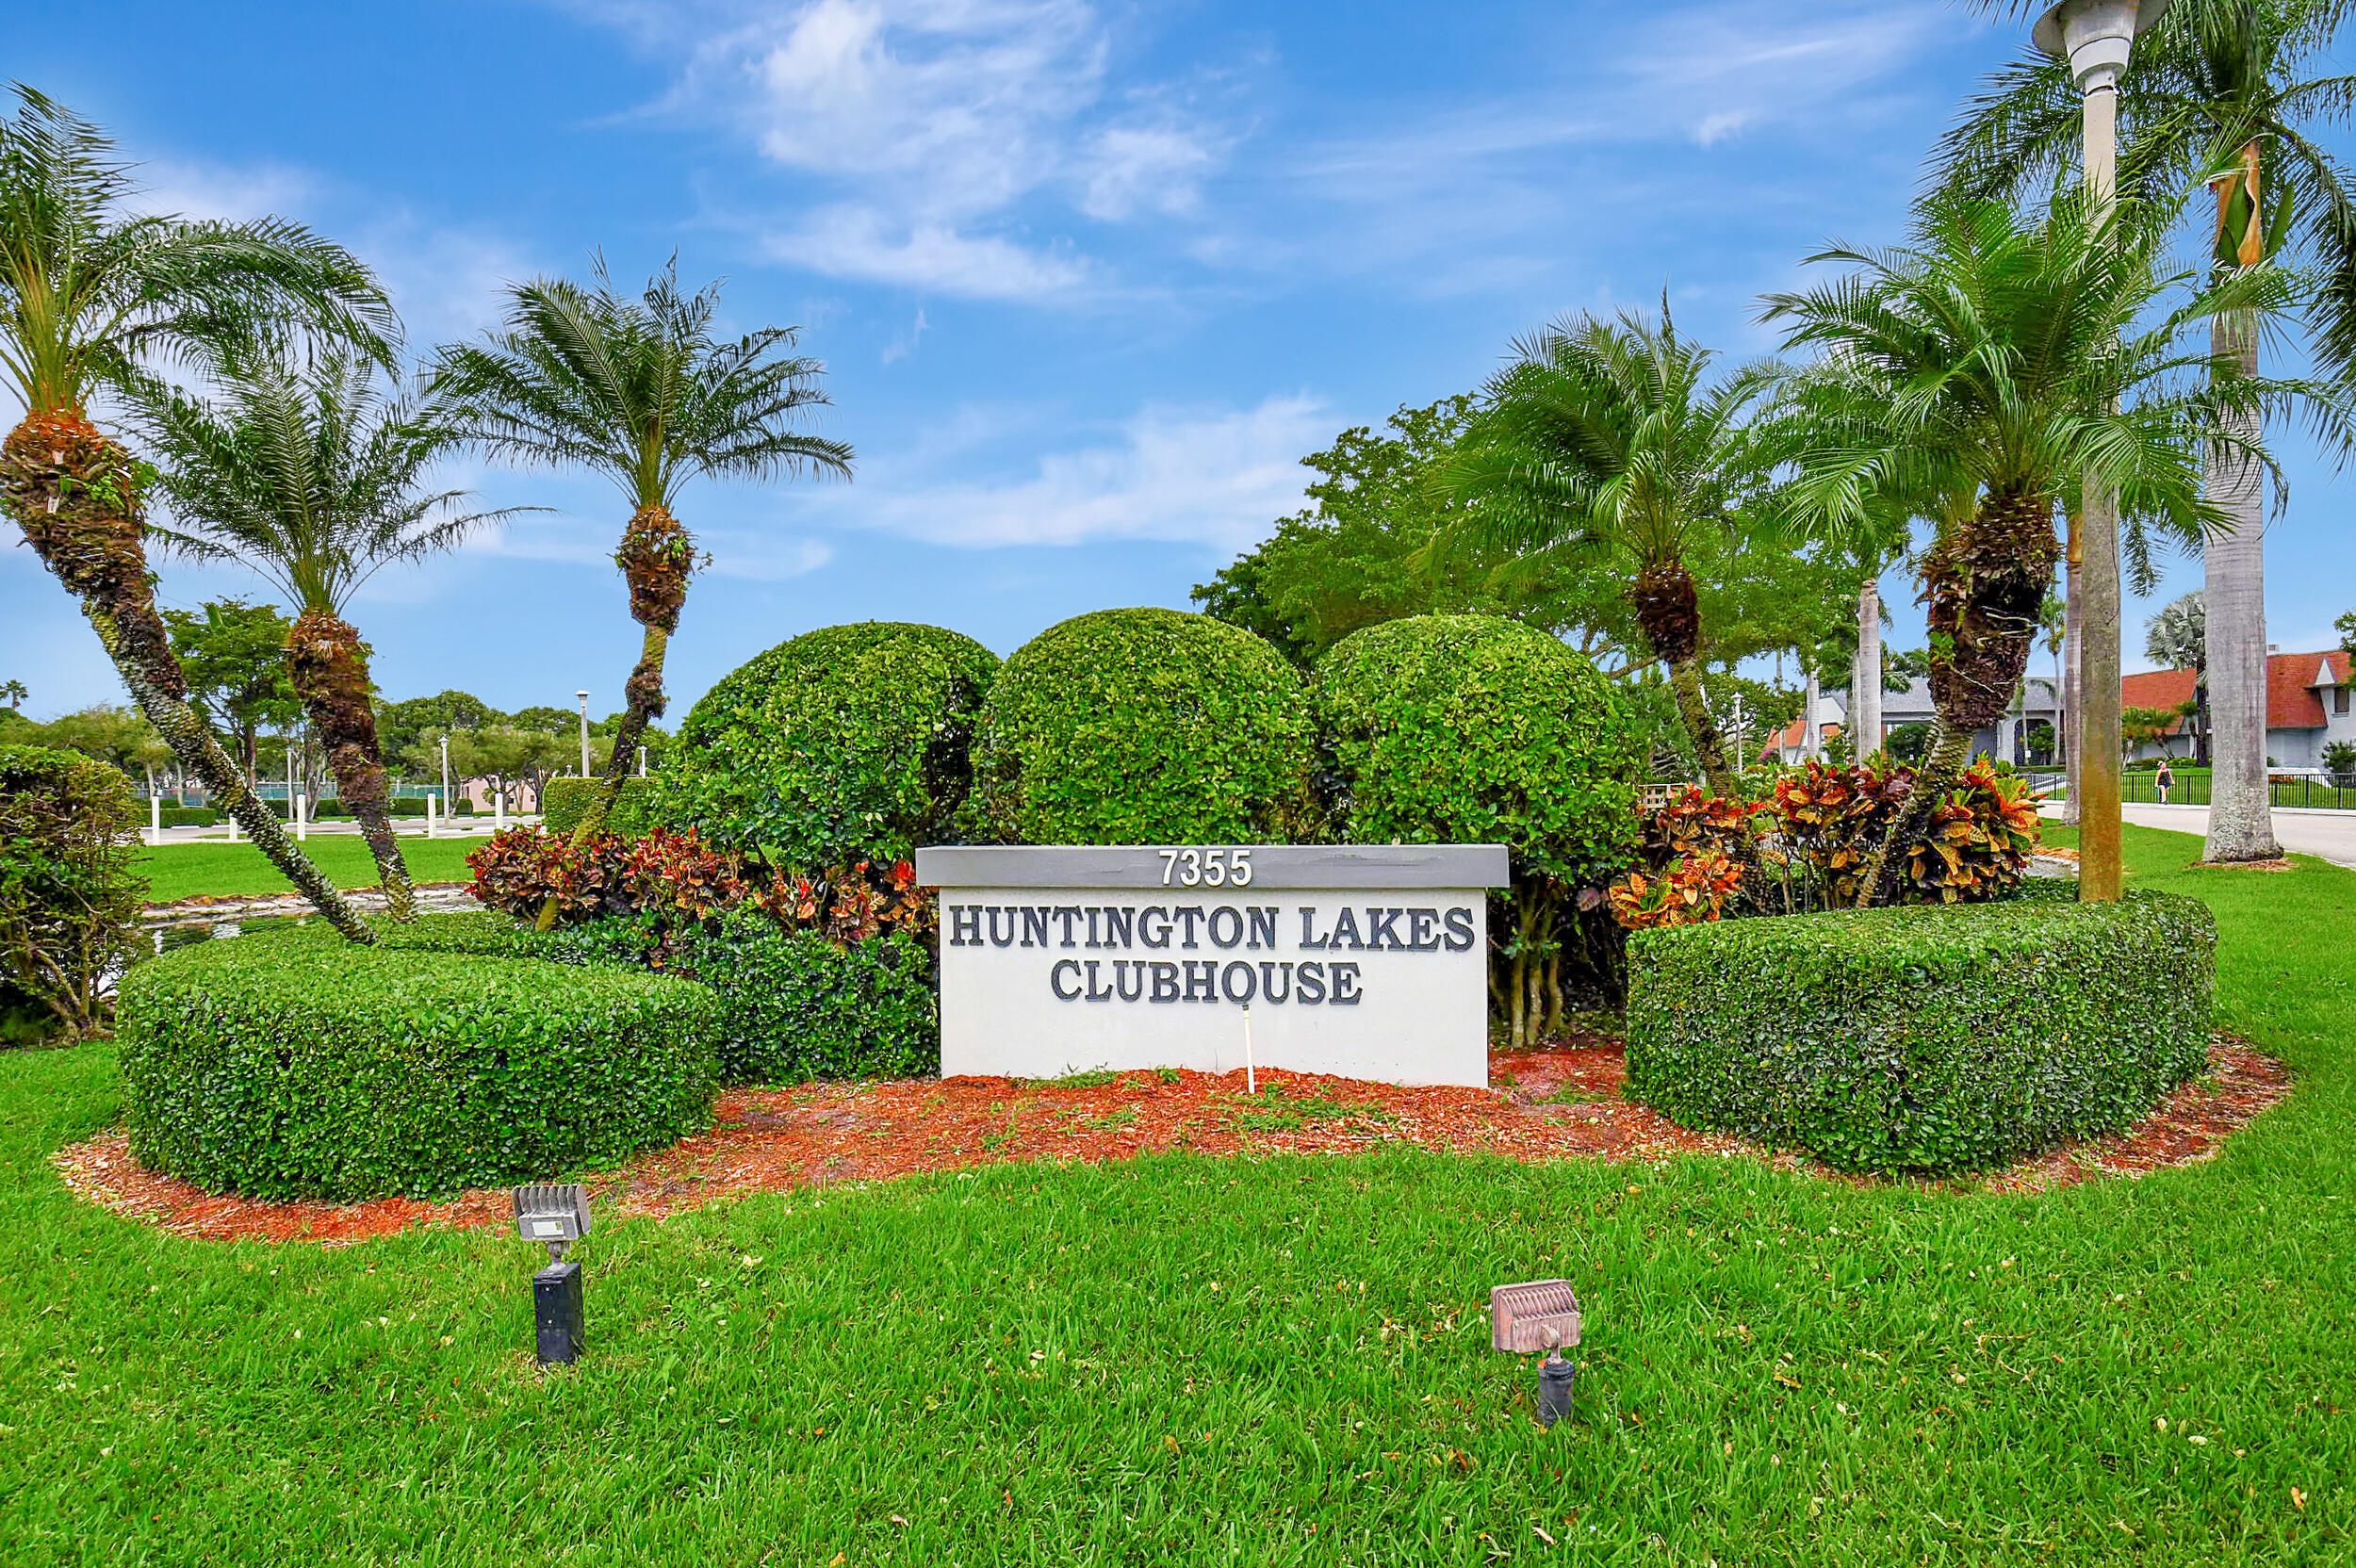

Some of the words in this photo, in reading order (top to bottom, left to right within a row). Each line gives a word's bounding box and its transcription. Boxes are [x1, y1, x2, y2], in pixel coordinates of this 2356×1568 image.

[1158, 850, 1253, 887] 7355
[949, 906, 1279, 949] HUNTINGTON
[1299, 906, 1476, 952] LAKES
[1051, 959, 1364, 1004] CLUBHOUSE
